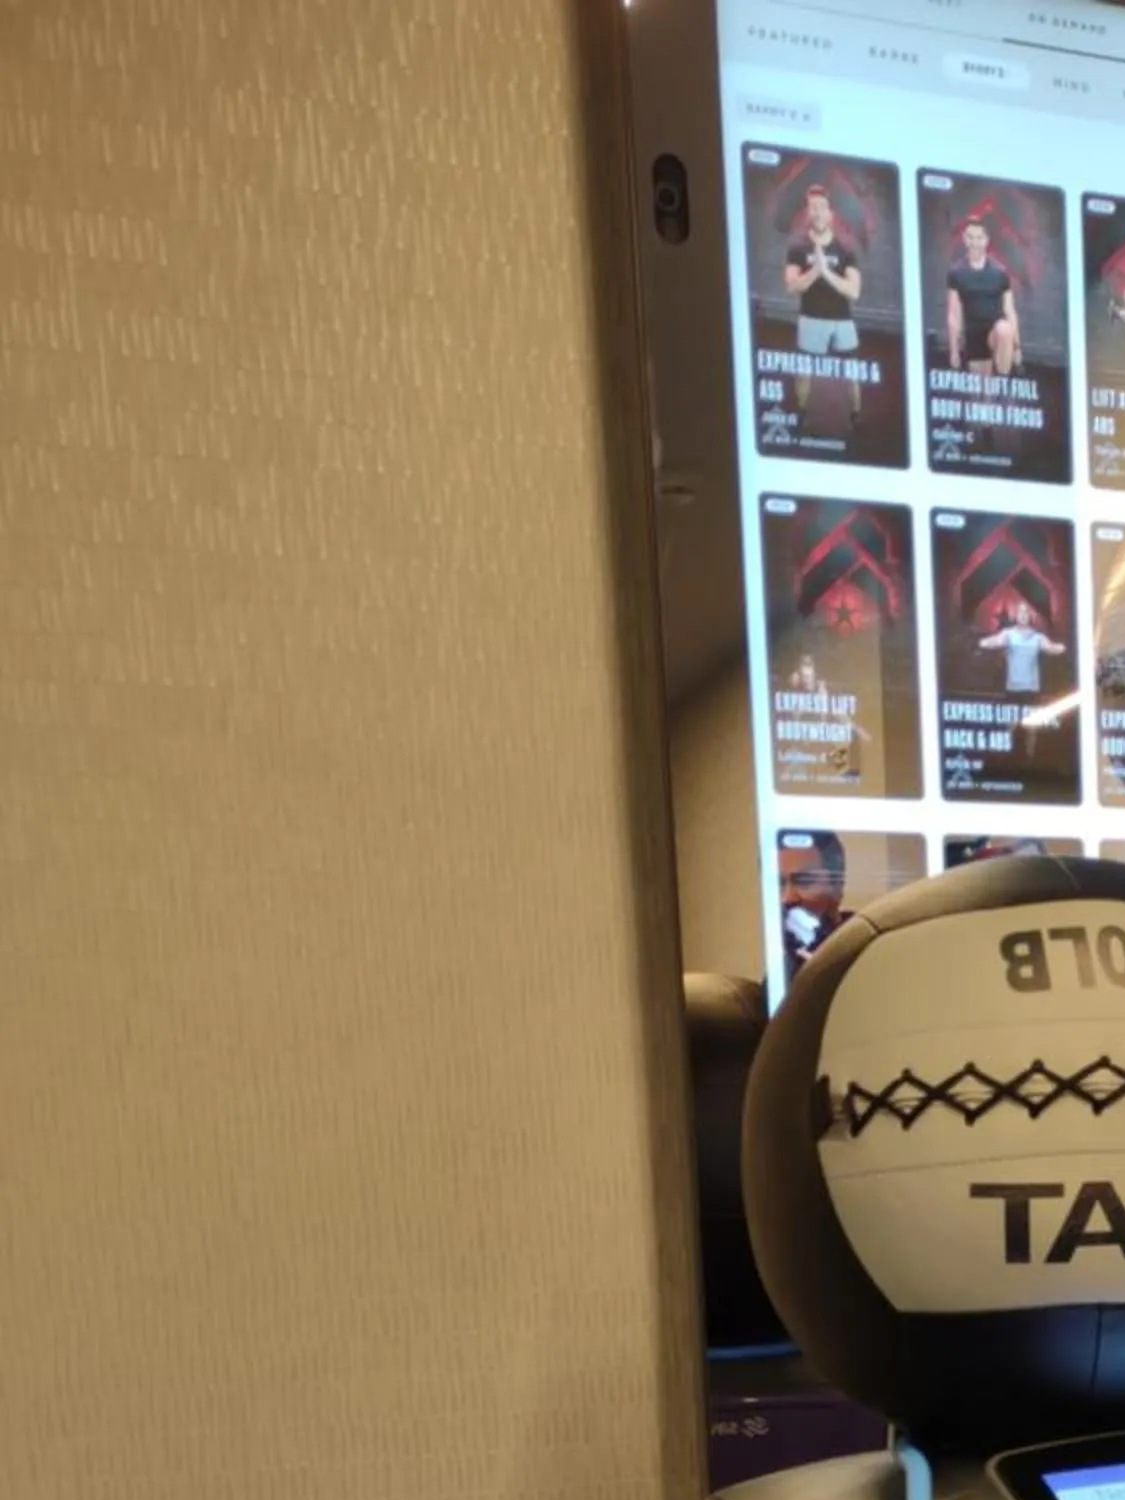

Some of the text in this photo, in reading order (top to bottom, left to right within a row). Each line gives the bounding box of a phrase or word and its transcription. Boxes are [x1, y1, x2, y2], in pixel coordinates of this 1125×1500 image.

[1052, 15, 1106, 35] DEMAND
[747, 24, 834, 50] FEATURED
[1052, 76, 1092, 94] MIND
[759, 350, 813, 375] EXPRESS
[815, 355, 840, 379] LIFT
[930, 369, 1039, 400] EXPRESS LIFT FULL
[1092, 388, 1116, 408] LIFT
[931, 397, 1043, 429] BODY LOWER FOCUS
[775, 692, 857, 715] EXPRESS LIFT
[943, 702, 994, 722] EXPRESS
[996, 704, 1021, 724] LIFT
[776, 720, 852, 742] BODYWEIGHT
[944, 728, 975, 750] BACK
[989, 732, 1012, 751] ABS
